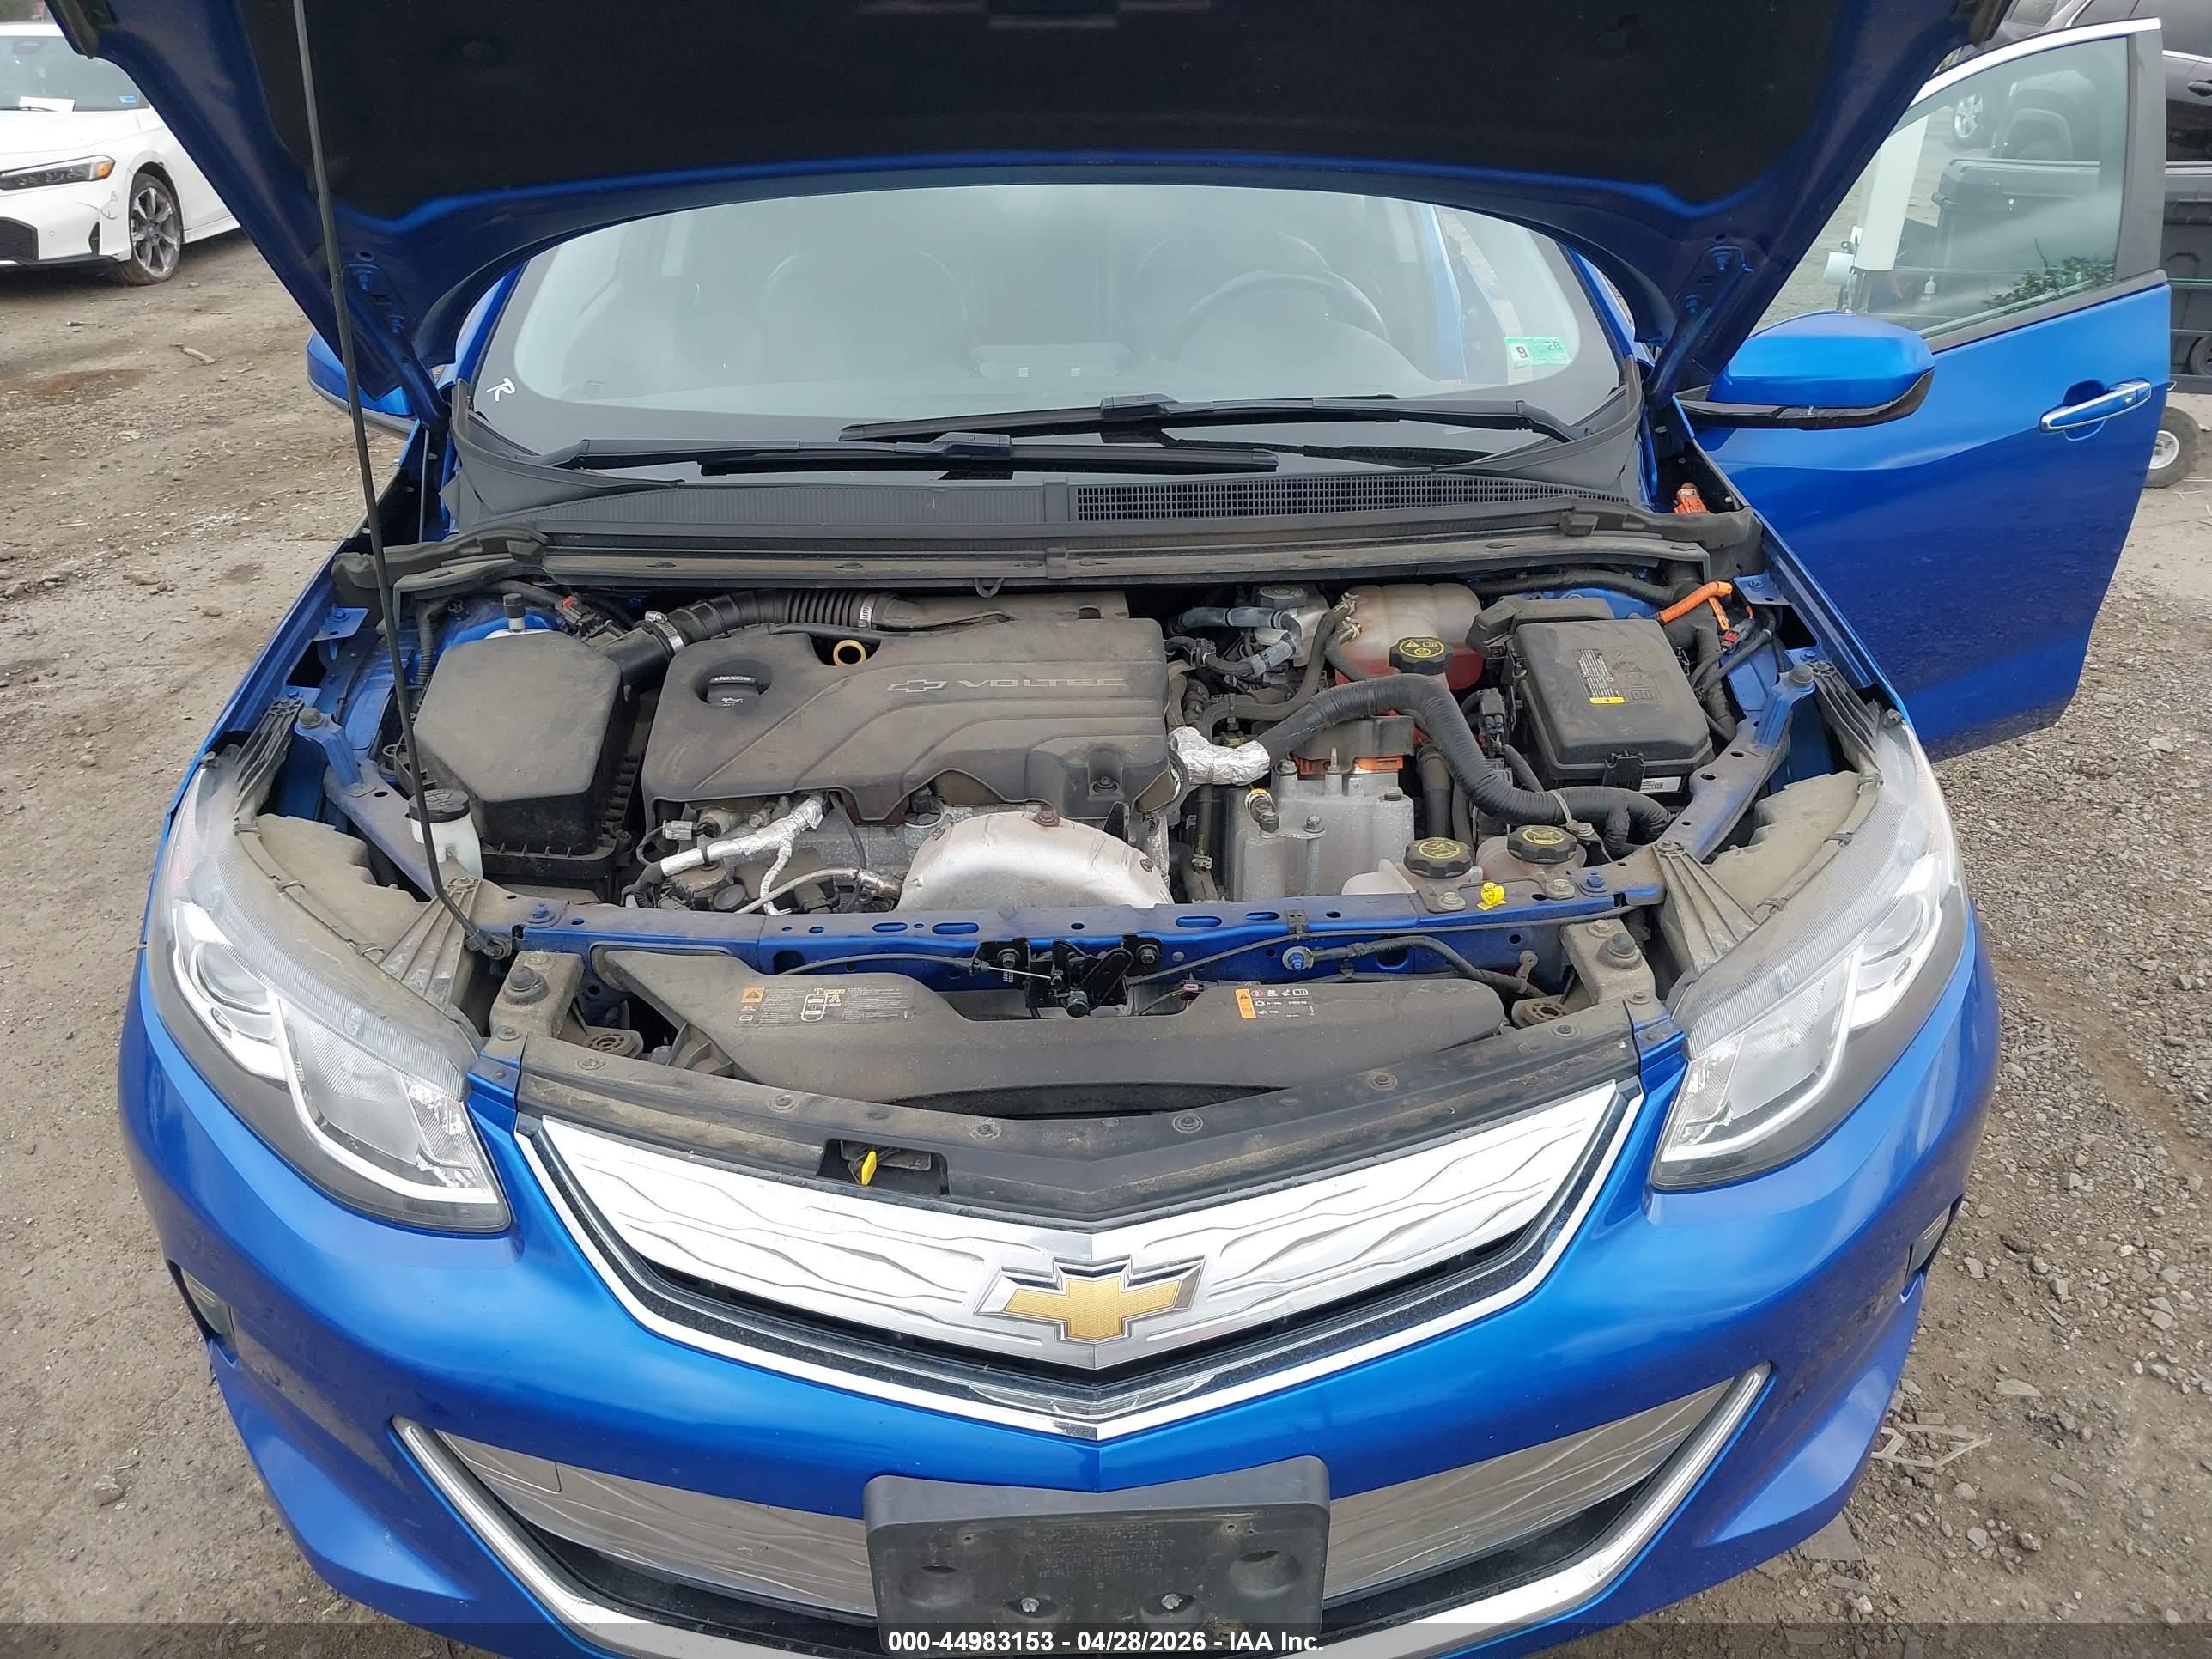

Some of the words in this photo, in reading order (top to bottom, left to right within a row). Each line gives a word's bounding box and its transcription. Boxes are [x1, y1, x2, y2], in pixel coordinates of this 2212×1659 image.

[1516, 346, 1528, 358] 9
[486, 377, 515, 402] R
[957, 678, 1125, 688] VOLTEC
